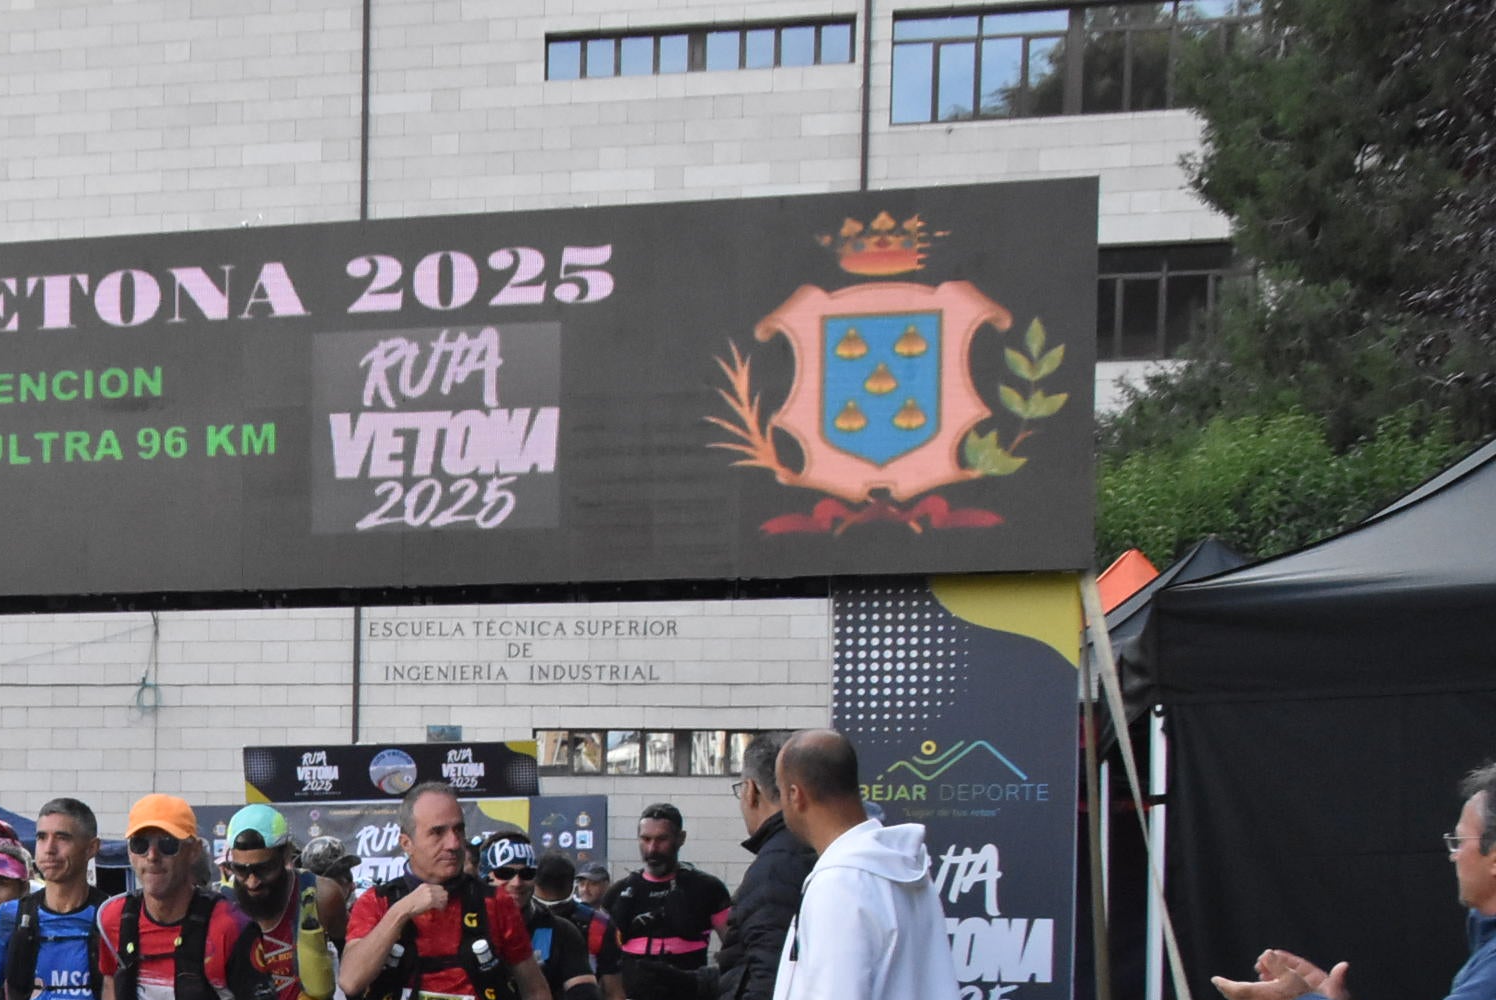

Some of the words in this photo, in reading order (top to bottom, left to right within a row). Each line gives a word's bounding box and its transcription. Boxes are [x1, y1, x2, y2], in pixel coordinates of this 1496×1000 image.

[346, 243, 615, 314] 2025
[359, 326, 503, 409] RUTA
[137, 426, 189, 461] 96
[206, 422, 276, 458] KM
[329, 406, 560, 479] VETONA
[355, 475, 518, 531] 2025
[368, 621, 465, 638] ESCUELA
[507, 642, 533, 659] DE
[529, 664, 661, 682] INDUSTRIAL
[940, 783, 1049, 801] DEPORTE
